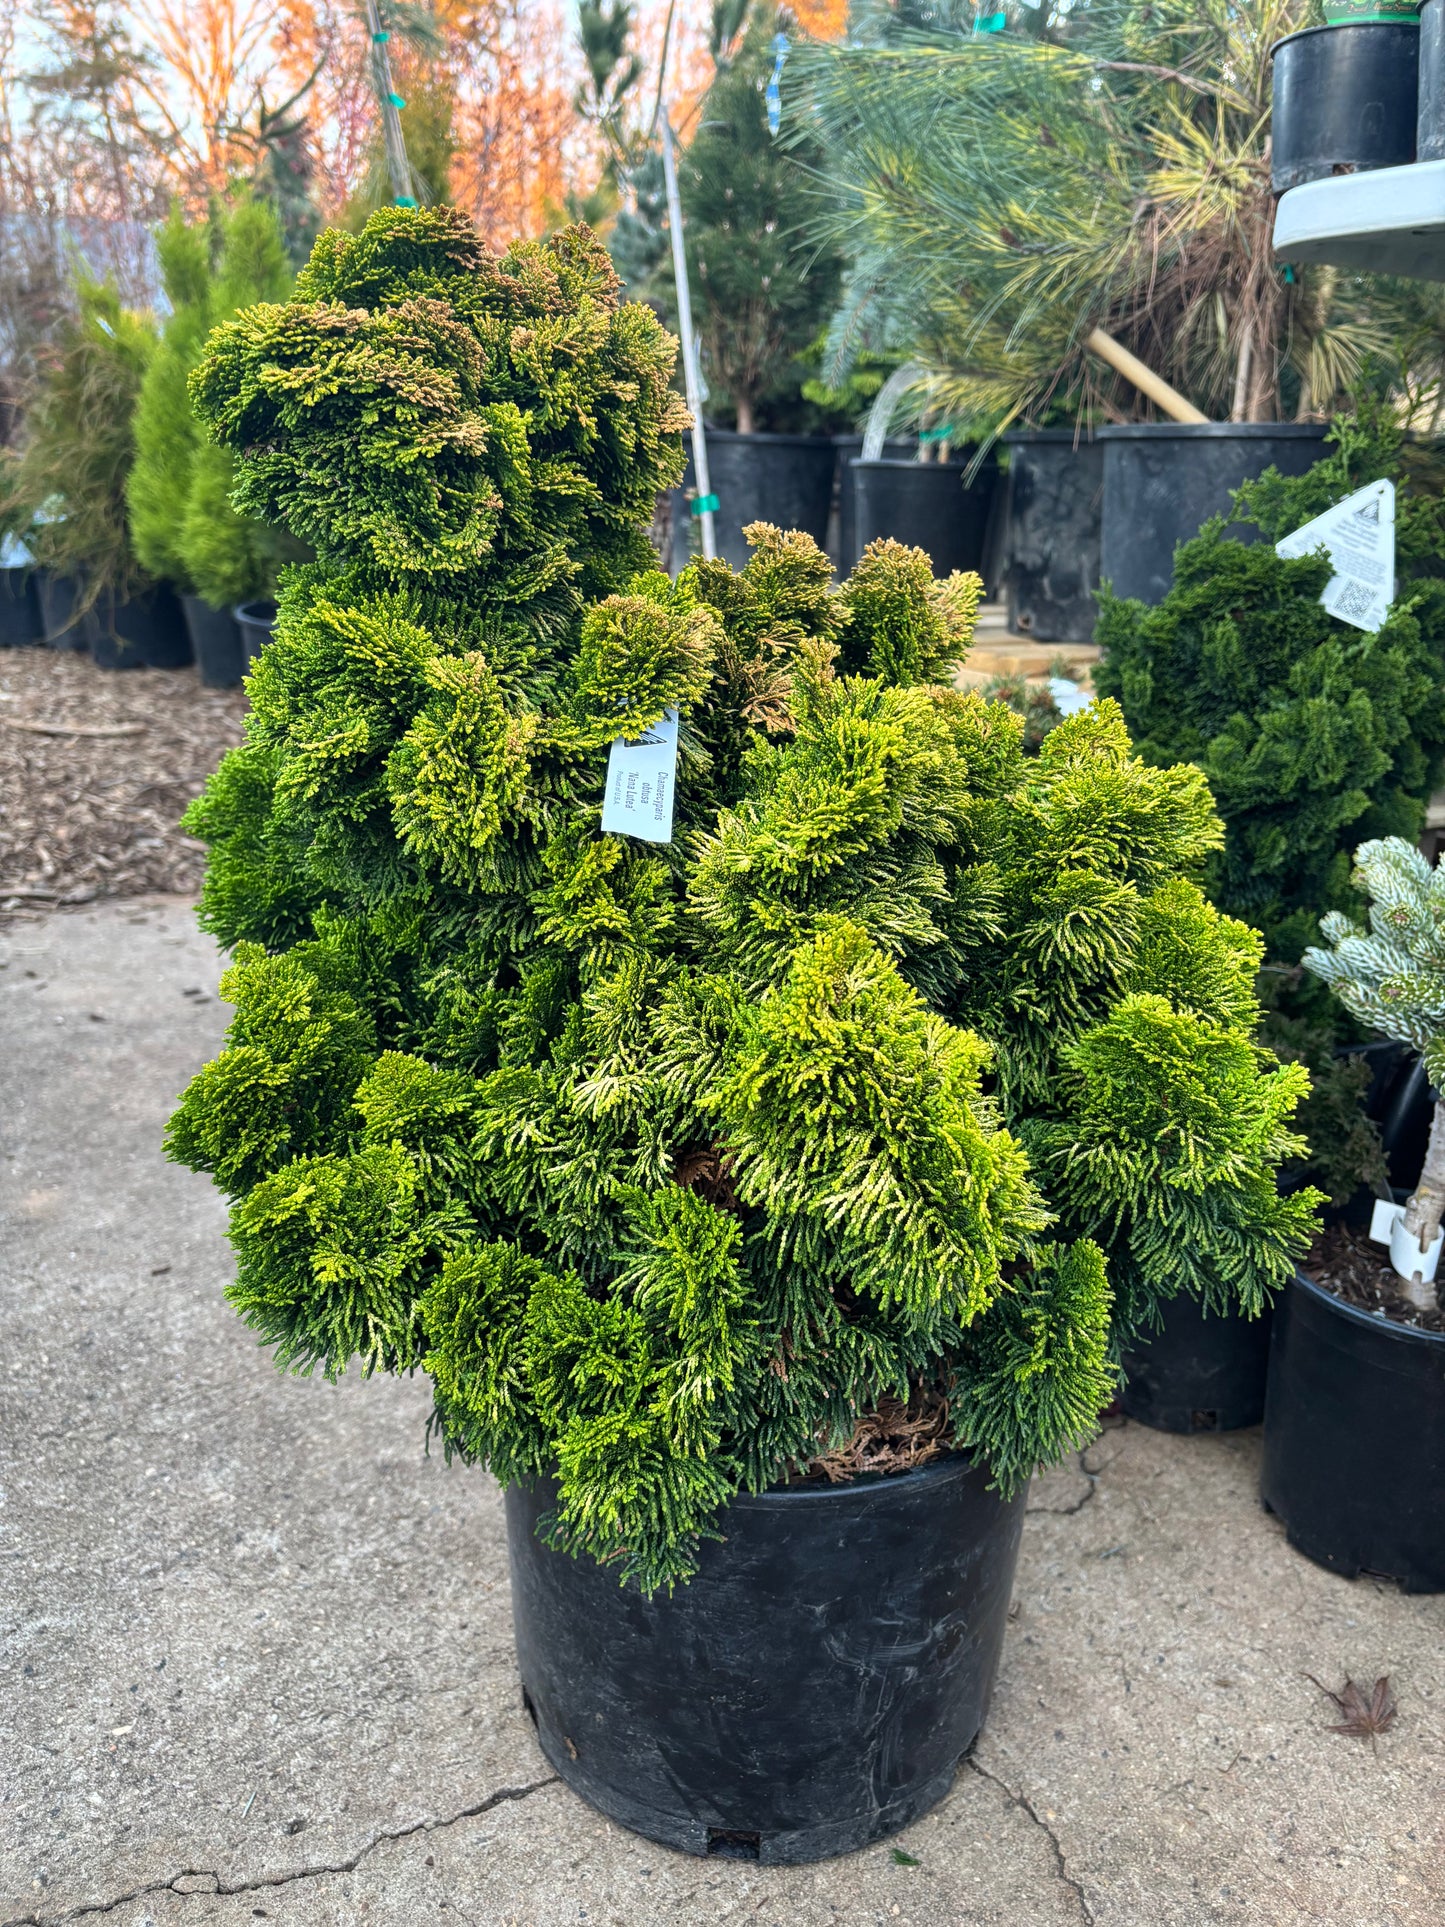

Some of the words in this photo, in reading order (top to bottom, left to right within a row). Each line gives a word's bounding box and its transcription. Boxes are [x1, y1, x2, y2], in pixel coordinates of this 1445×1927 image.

[615, 770, 624, 787] Product
[641, 783, 652, 804] obtusa
[653, 772, 669, 821] Chamaecyparis
